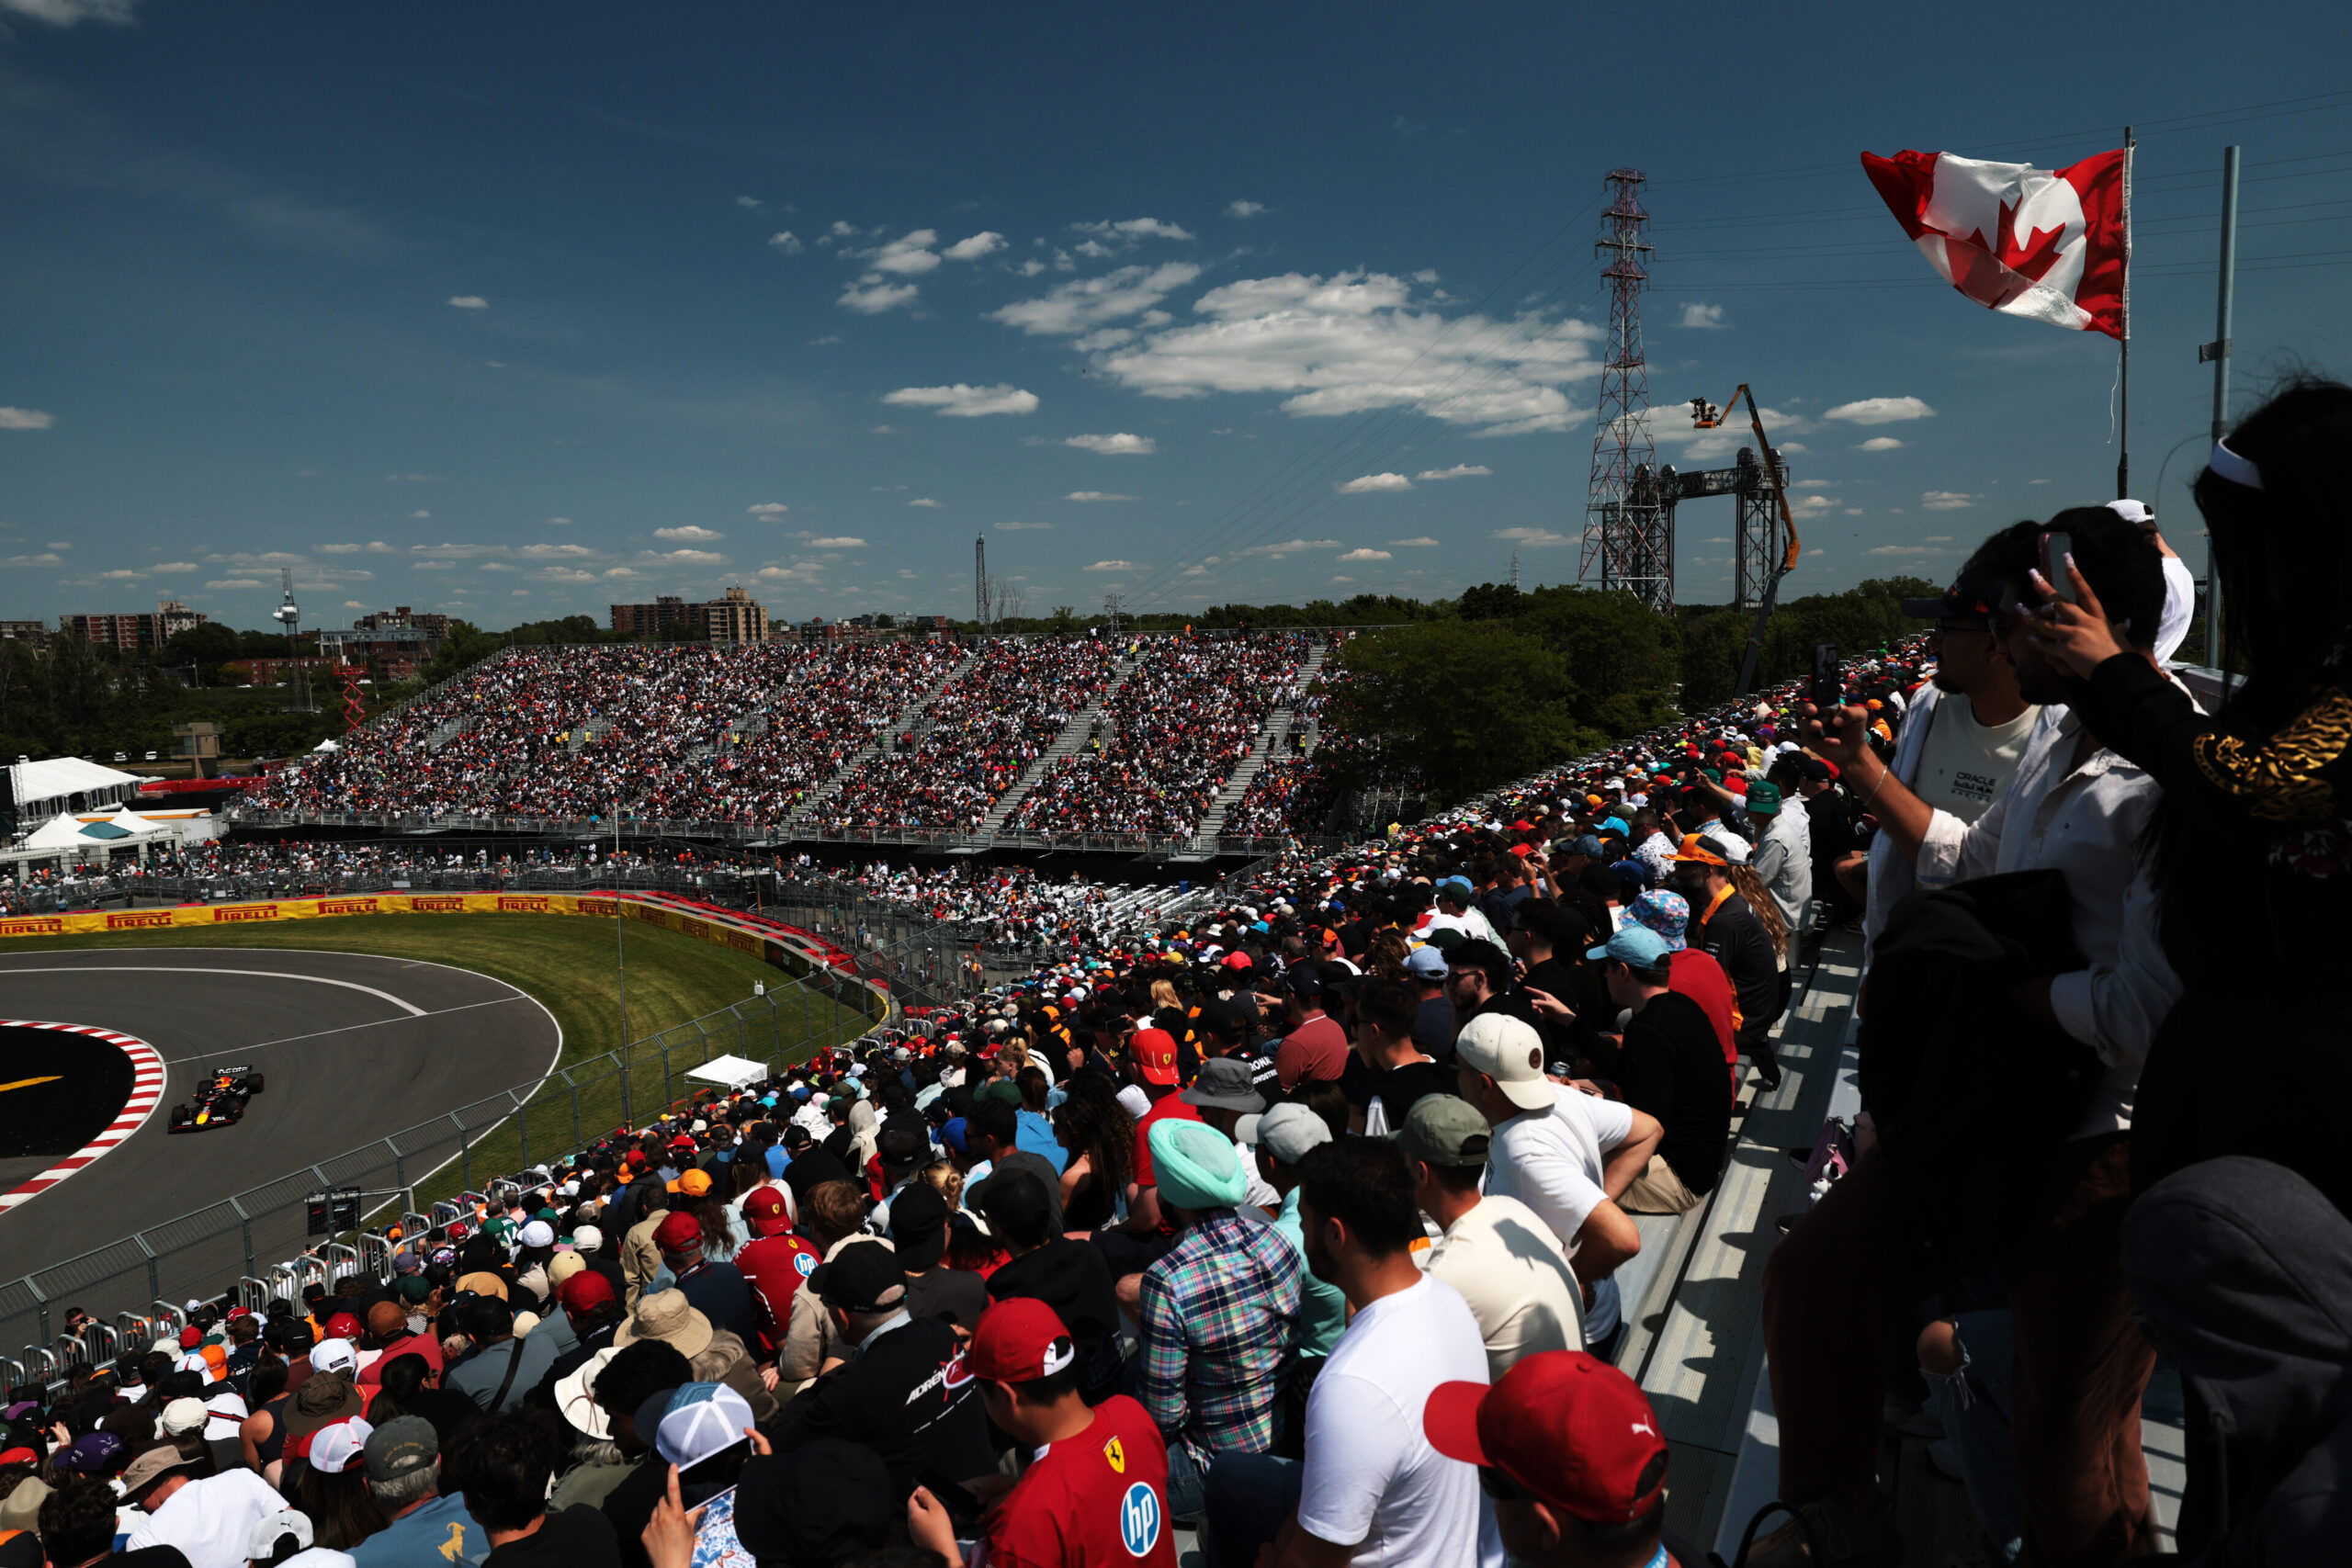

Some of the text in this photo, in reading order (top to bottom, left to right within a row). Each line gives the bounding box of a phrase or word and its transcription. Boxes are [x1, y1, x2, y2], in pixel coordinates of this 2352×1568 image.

[1956, 772, 1996, 786] ORACLE
[1951, 789, 1991, 802] RACING
[318, 898, 378, 914] PIRELLI
[412, 897, 464, 910] PIRELLI
[498, 897, 548, 910] PIRELLI
[107, 911, 172, 928] PIRELLI
[214, 905, 277, 920] PIRELLI
[640, 906, 665, 926] PIRELLI
[0, 919, 62, 934] PIRELLI
[683, 917, 709, 939] PIRELLI
[727, 930, 755, 953] PIRELLI
[797, 1254, 816, 1276] hp
[1125, 1489, 1155, 1554] hp
